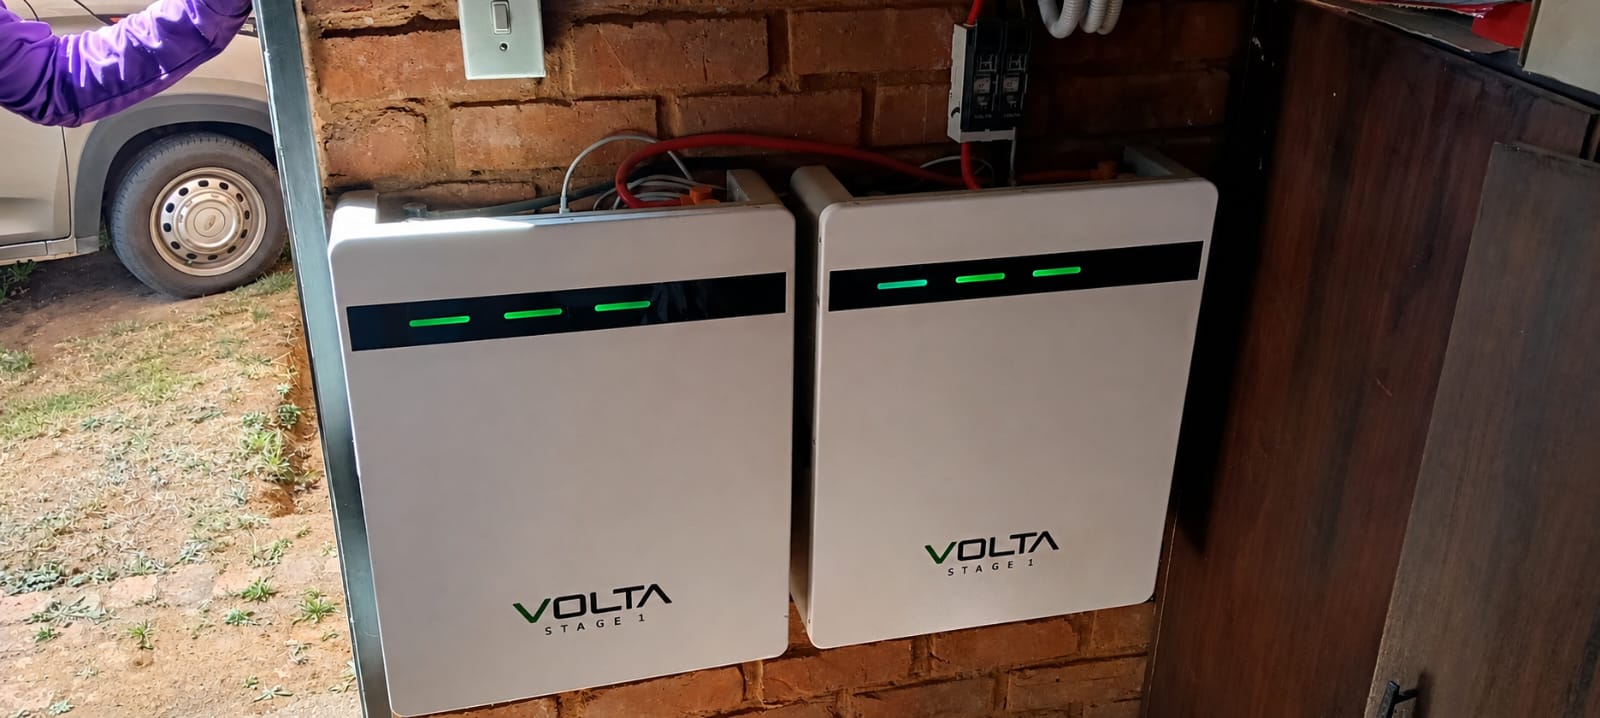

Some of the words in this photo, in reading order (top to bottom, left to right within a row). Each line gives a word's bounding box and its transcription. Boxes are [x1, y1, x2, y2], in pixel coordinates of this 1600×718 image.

[924, 530, 1060, 565] VOLTA
[947, 560, 1014, 577] STAGE
[1027, 558, 1034, 567] 1
[512, 583, 673, 624] VOLTA
[544, 616, 622, 636] STAGE
[638, 613, 645, 622] 1
